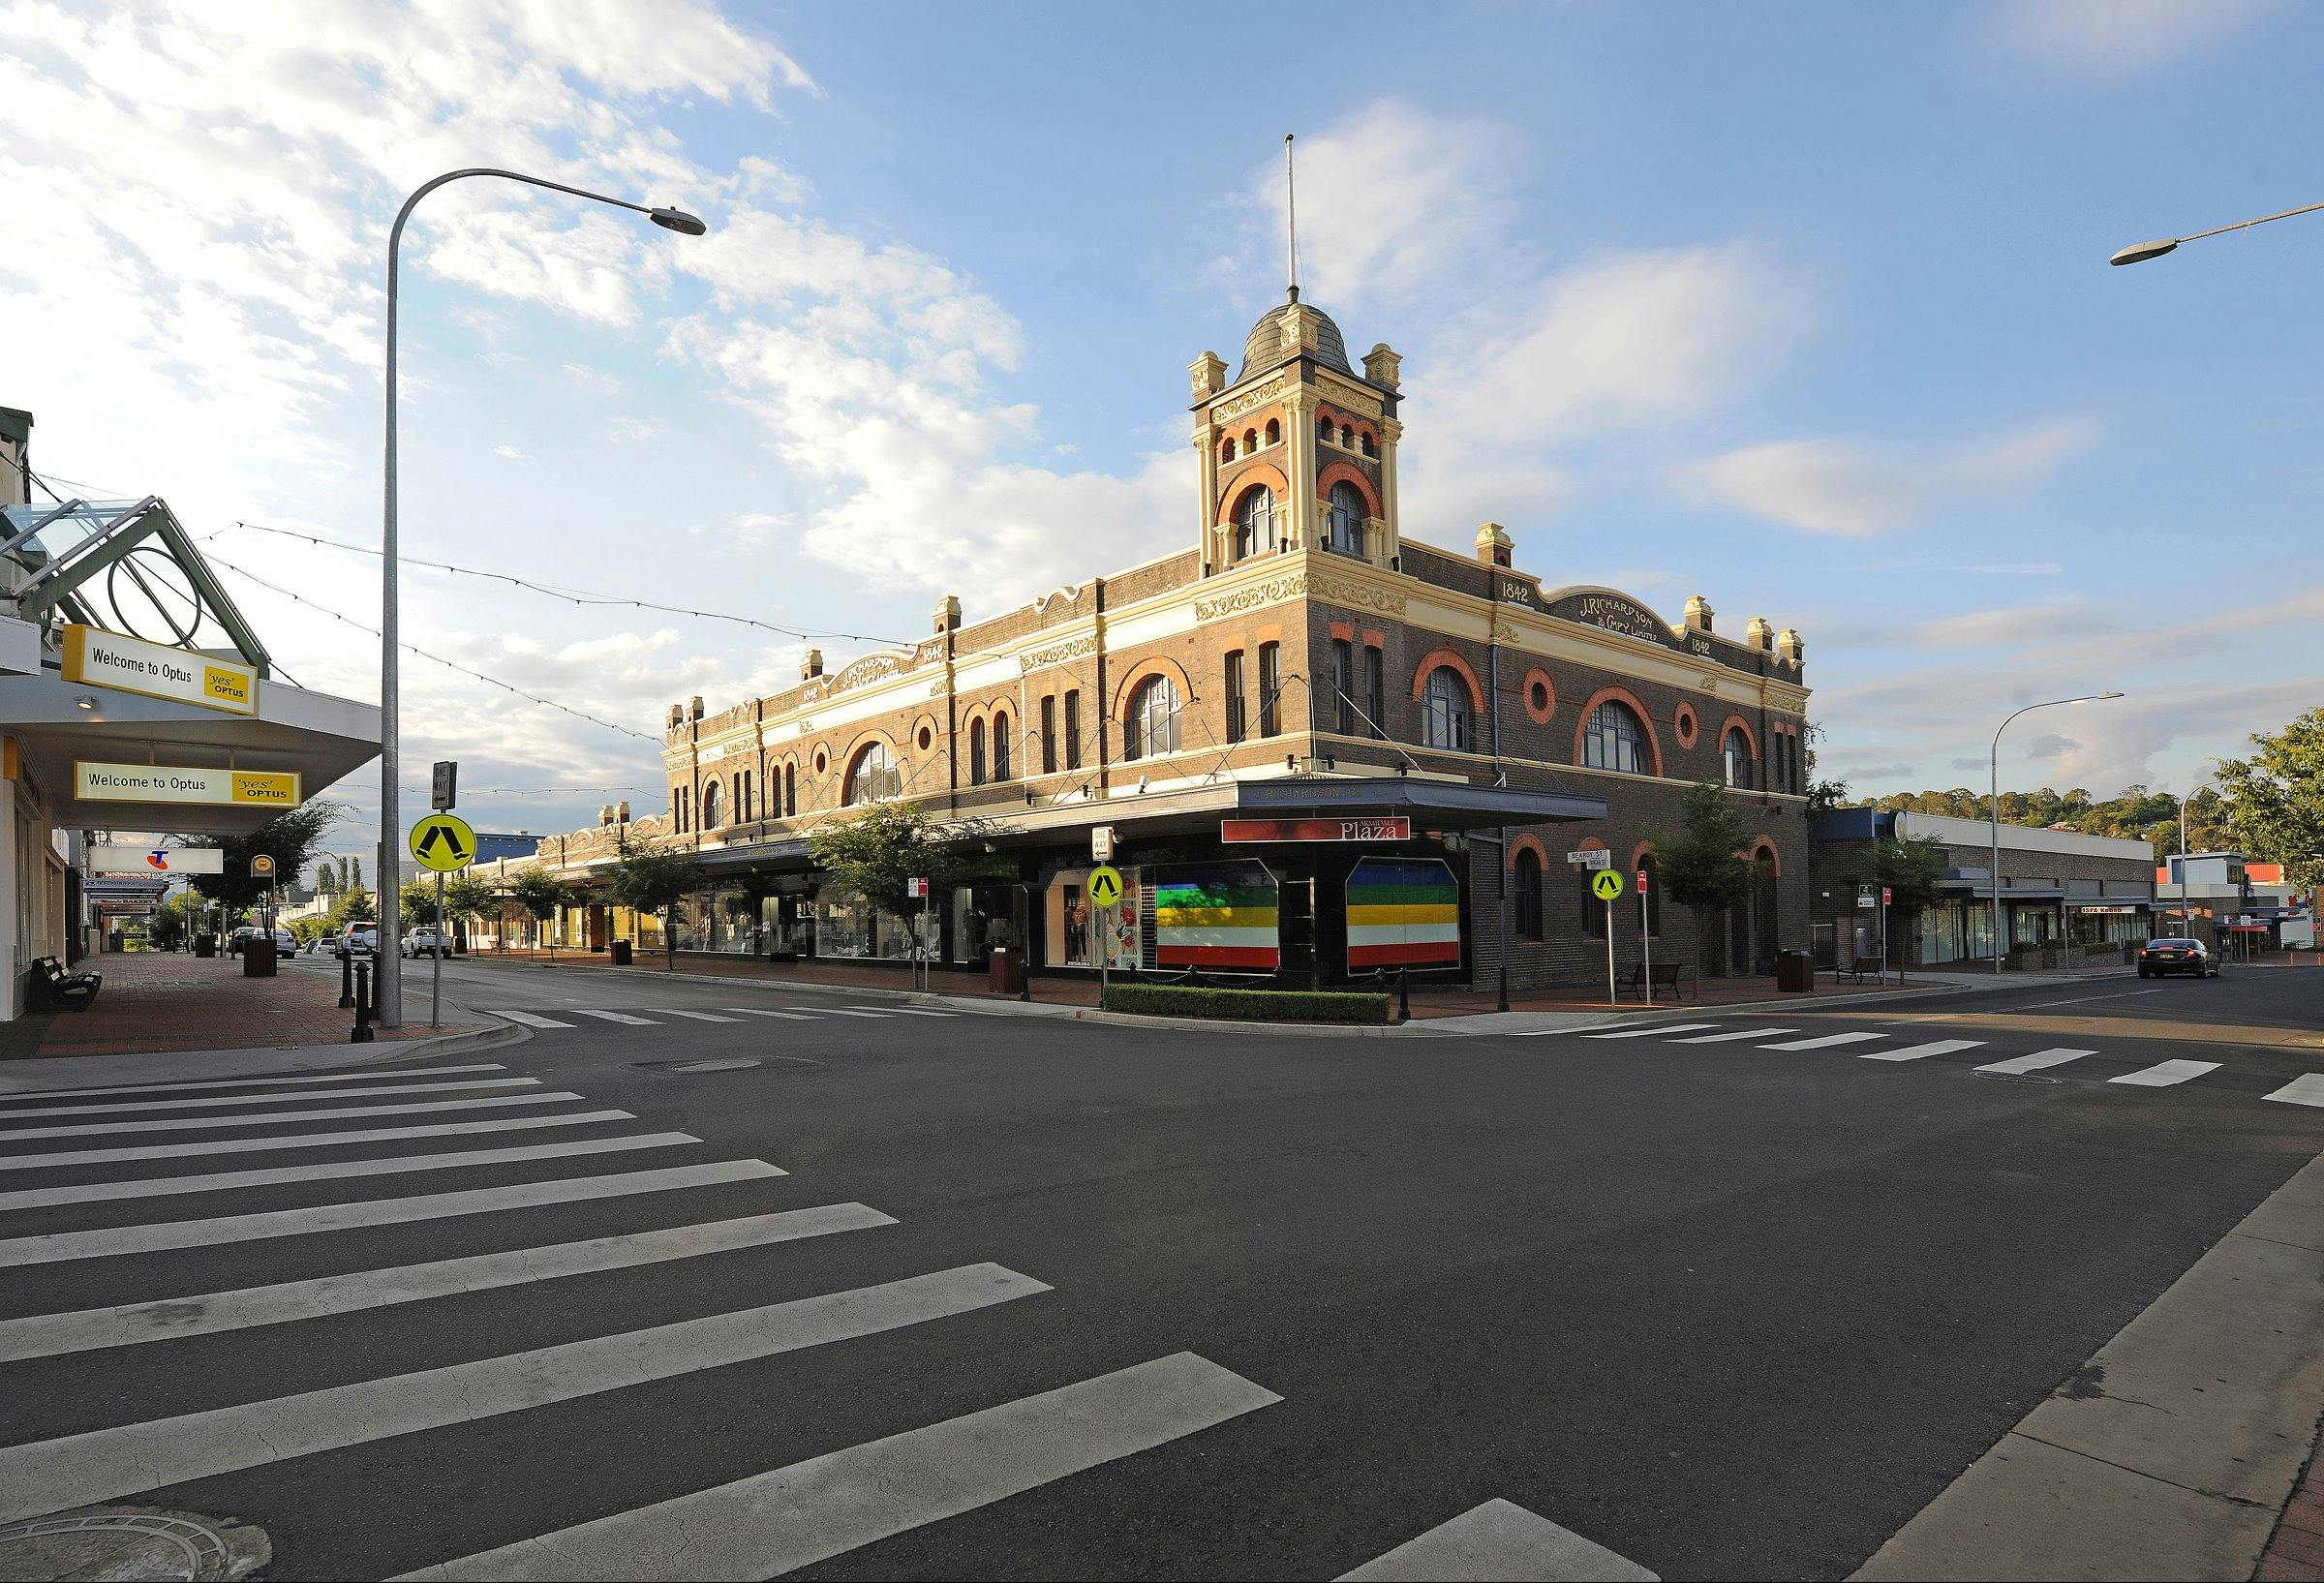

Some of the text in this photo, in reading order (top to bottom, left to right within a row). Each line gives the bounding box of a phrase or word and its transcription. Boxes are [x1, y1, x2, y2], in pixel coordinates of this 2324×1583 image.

[1502, 581, 1528, 602] 1842
[1692, 639, 1710, 655] 1842
[92, 647, 192, 683] Welcome to Optus
[214, 685, 244, 698] OPTUS
[436, 766, 446, 777] ONE
[88, 773, 206, 792] Welcome to Optus
[435, 780, 447, 791] WAY
[247, 789, 288, 799] OPTUS
[1094, 830, 1106, 838] ONE
[1340, 821, 1399, 840] Plaza
[1094, 839, 1107, 848] WAY
